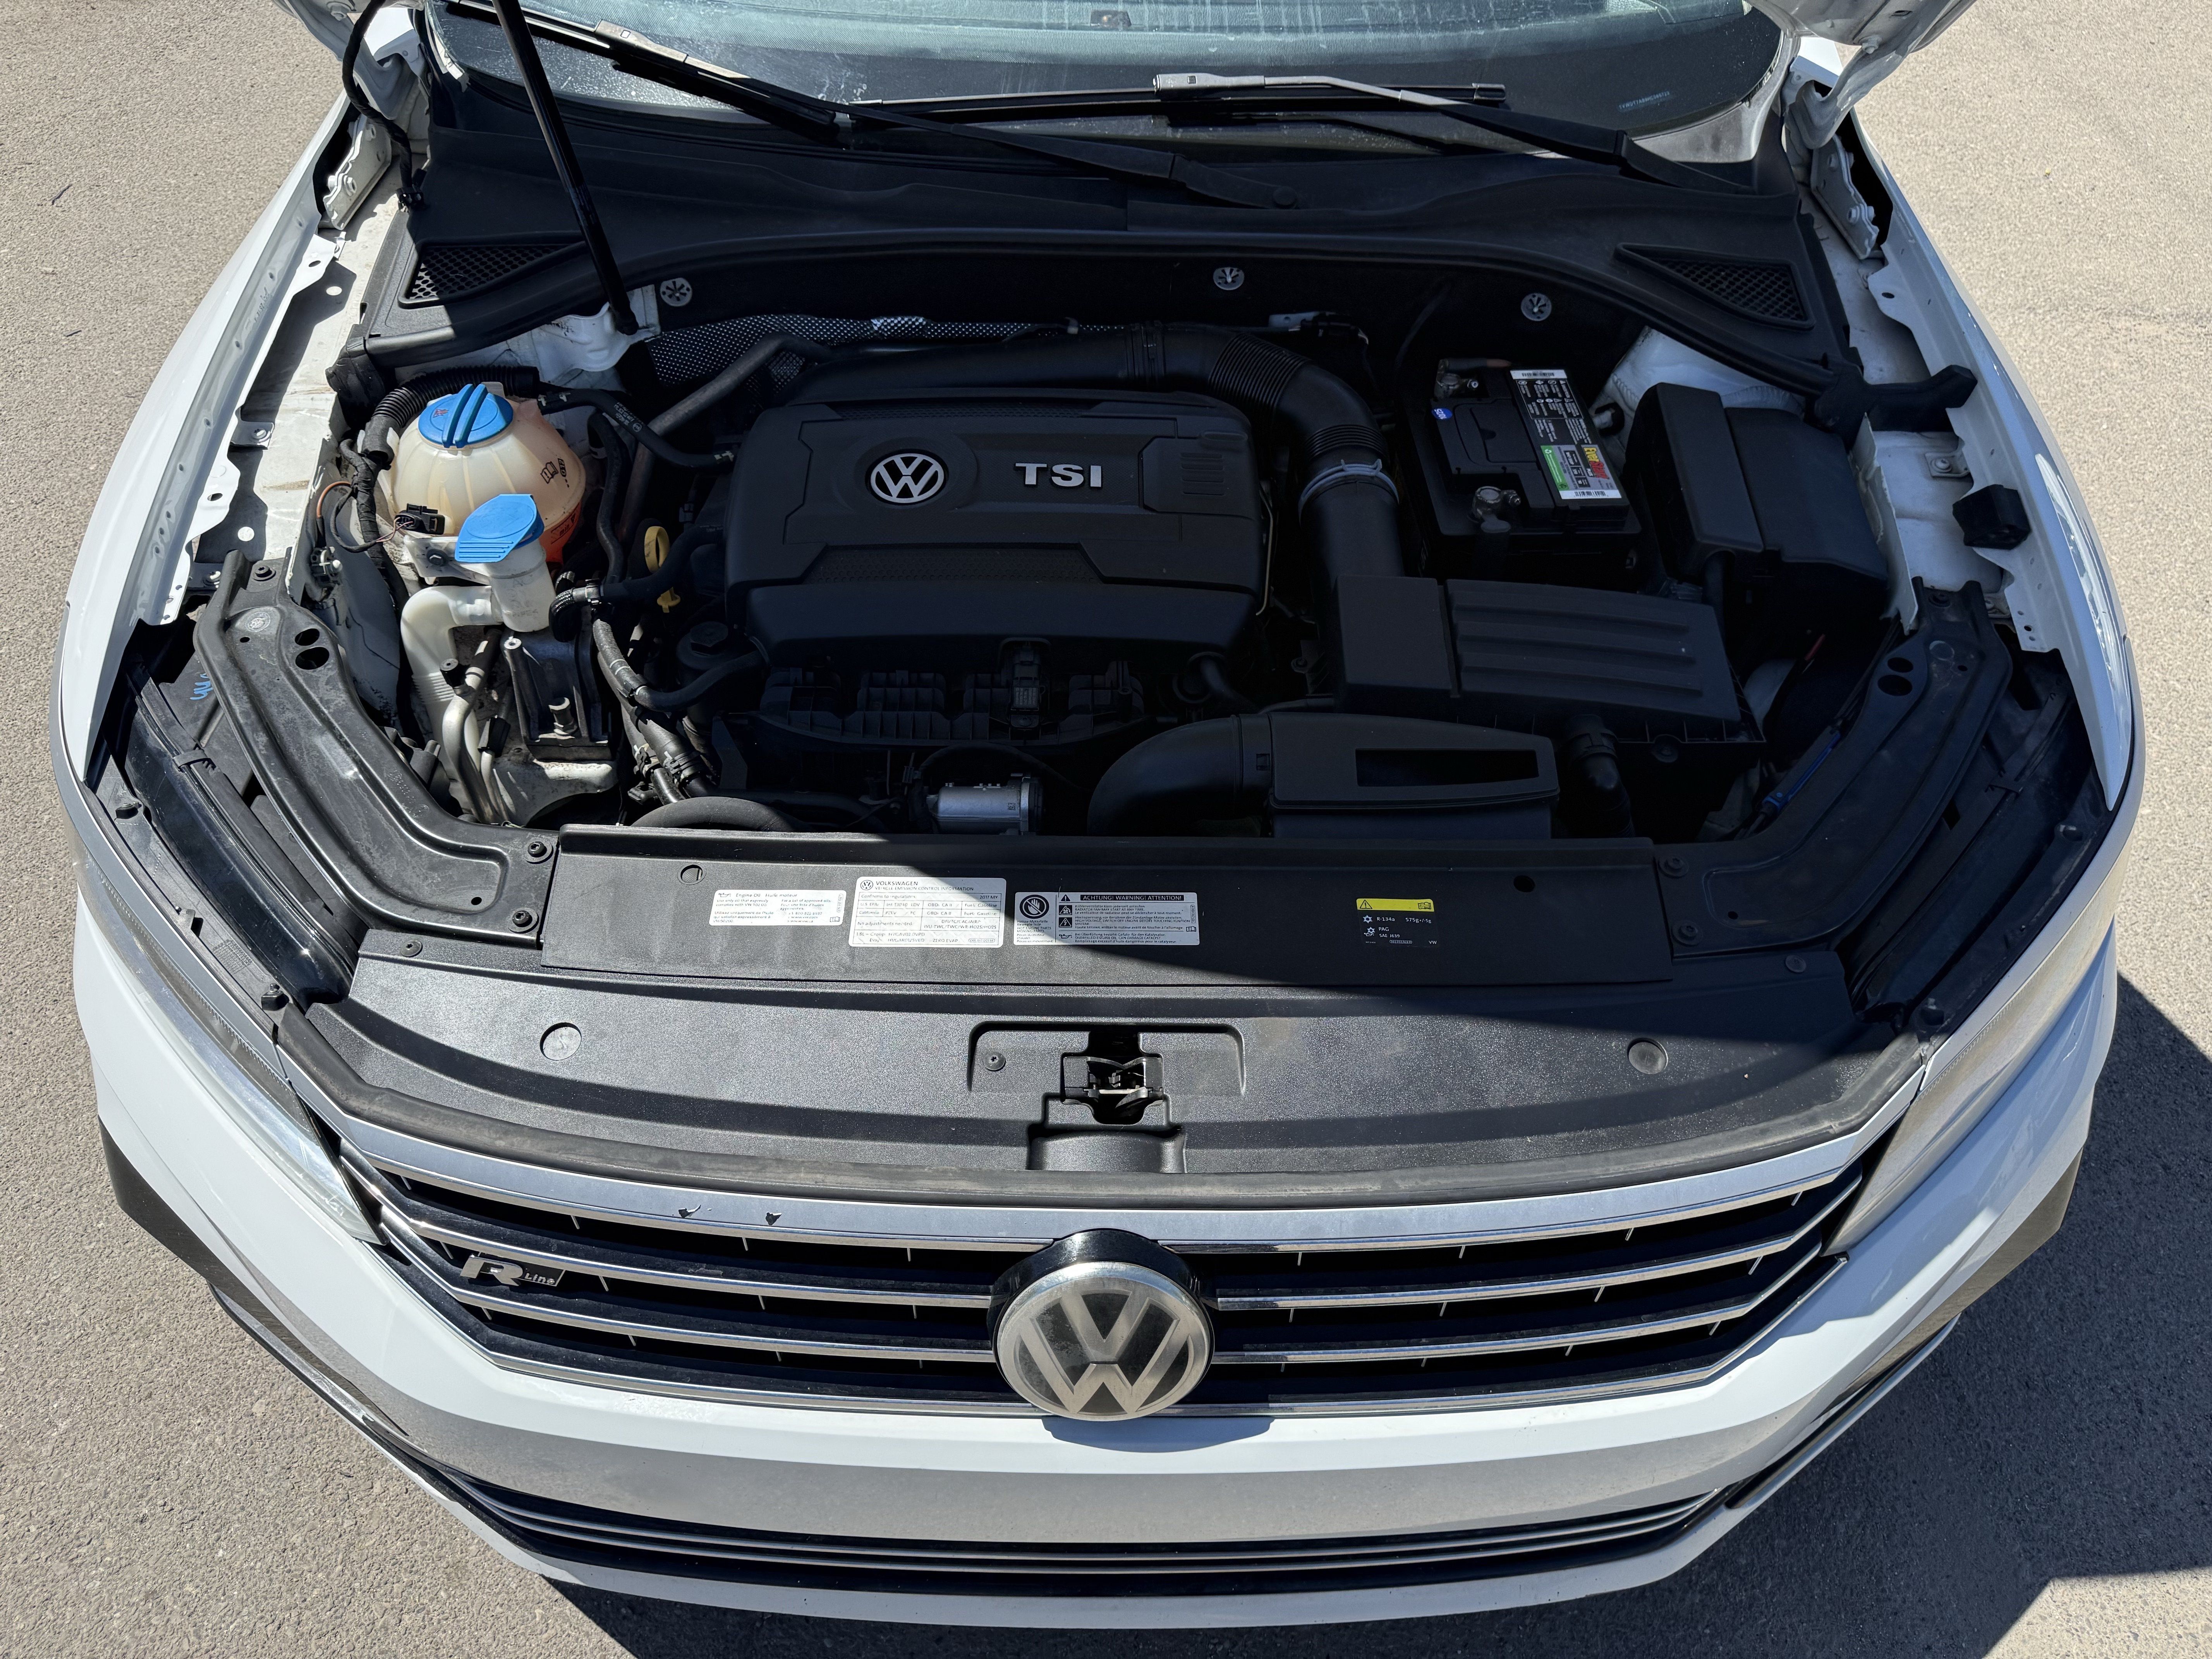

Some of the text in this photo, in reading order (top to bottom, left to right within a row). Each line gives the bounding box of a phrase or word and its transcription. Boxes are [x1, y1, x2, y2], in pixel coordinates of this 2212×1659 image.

[1016, 463, 1101, 487] TSI
[1583, 447, 1609, 480] EverStart
[460, 1255, 555, 1286] R Line
[998, 1262, 1213, 1421] VW
